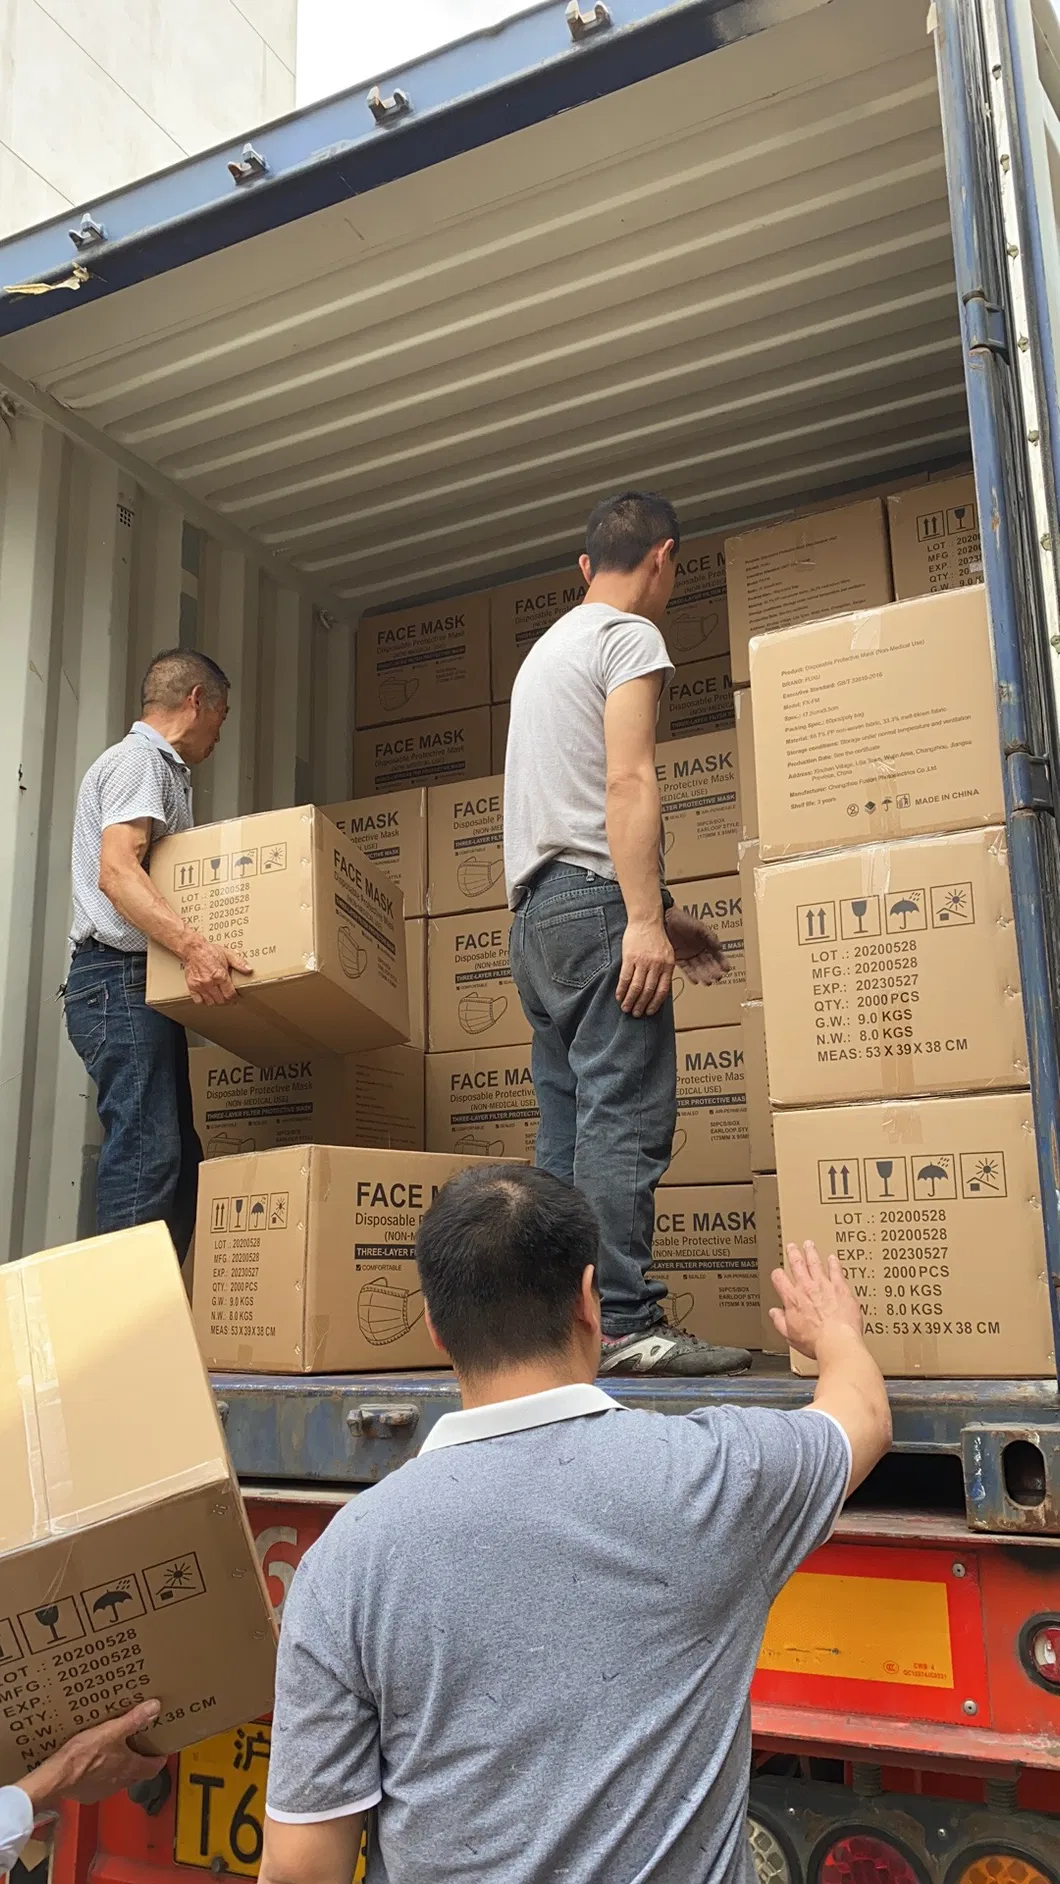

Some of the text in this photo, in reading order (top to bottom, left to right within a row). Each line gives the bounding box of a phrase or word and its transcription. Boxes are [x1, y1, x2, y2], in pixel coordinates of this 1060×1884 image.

[927, 541, 946, 553] LOT
[674, 555, 714, 578] ACE
[515, 592, 558, 615] FACE
[377, 613, 466, 645] FACE MASK
[669, 676, 717, 702] FACE
[375, 728, 465, 758] FACE MASK
[673, 751, 734, 779] MASK
[664, 771, 735, 792] Protective Mask
[915, 788, 980, 806] MADE IN CHINA
[453, 795, 501, 819] FACE
[350, 810, 400, 834] MASK
[453, 816, 495, 831] Disposable
[181, 882, 250, 904] LOT 20200528
[333, 849, 363, 891] FACE
[365, 877, 394, 919] MASK
[209, 893, 250, 909] 20200528
[208, 905, 250, 921] 20230527
[208, 916, 250, 932] 2000 PCS
[208, 928, 245, 944] 9.0 KGS
[455, 929, 502, 952] FACE
[249, 945, 277, 959] 38 CM
[454, 949, 497, 964] Disposable
[811, 939, 918, 964] LOT 20200528
[855, 956, 919, 975] 20200528
[813, 973, 920, 997] EXP.: 20230527
[814, 990, 921, 1013] QTY.: 2000 PCS
[858, 1011, 878, 1026] 9.0
[881, 1008, 913, 1023] KGS
[859, 1029, 879, 1043] 8.0
[882, 1025, 914, 1040] KGS
[817, 1037, 969, 1063] MEAS: 53 X 39 X 38 CM
[207, 1060, 313, 1088] FACE MASK
[450, 1067, 534, 1091] FACE MA
[206, 1087, 248, 1100] Disposable
[249, 1083, 290, 1096] Protective
[450, 1092, 494, 1104] Disposable
[704, 1085, 722, 1095] USE)
[690, 1096, 731, 1106] PROTECTIVE
[356, 1181, 423, 1209] FACE
[355, 1212, 416, 1229] Disposable
[656, 1210, 757, 1233] CE MASK
[834, 1208, 947, 1225] LOT 20200528
[682, 1233, 732, 1246] Protective
[881, 1227, 948, 1242] 20200528
[214, 1239, 227, 1250] LOT
[356, 1247, 409, 1257] THREE-LAYER
[653, 1248, 730, 1259] (NON-MEDICAL USE)
[882, 1246, 949, 1261] 20230527
[361, 1263, 402, 1272] COMFORTABLE
[675, 1259, 739, 1269] FILTER PROTECTIVE
[883, 1264, 950, 1280] 2000 PCS
[245, 1281, 258, 1291] PCS
[884, 1283, 943, 1299] 9.0 KGS
[240, 1296, 254, 1306] KGS
[886, 1302, 908, 1317] 8.0
[911, 1302, 943, 1316] KGS
[240, 1311, 253, 1321] KGS
[266, 1326, 276, 1337] CM
[892, 1320, 1000, 1335] 53 X 39 X 38 CM
[52, 1628, 137, 1667] 20200528
[57, 1644, 142, 1683] 20200528
[3, 1659, 145, 1719] EXP.: 20230527
[9, 1674, 151, 1732] QTY.: 2000 PCS
[74, 1708, 101, 1726] 9.0
[104, 1691, 145, 1714] KGS
[166, 1695, 217, 1724] 38 CM
[233, 1728, 271, 1771] 沪
